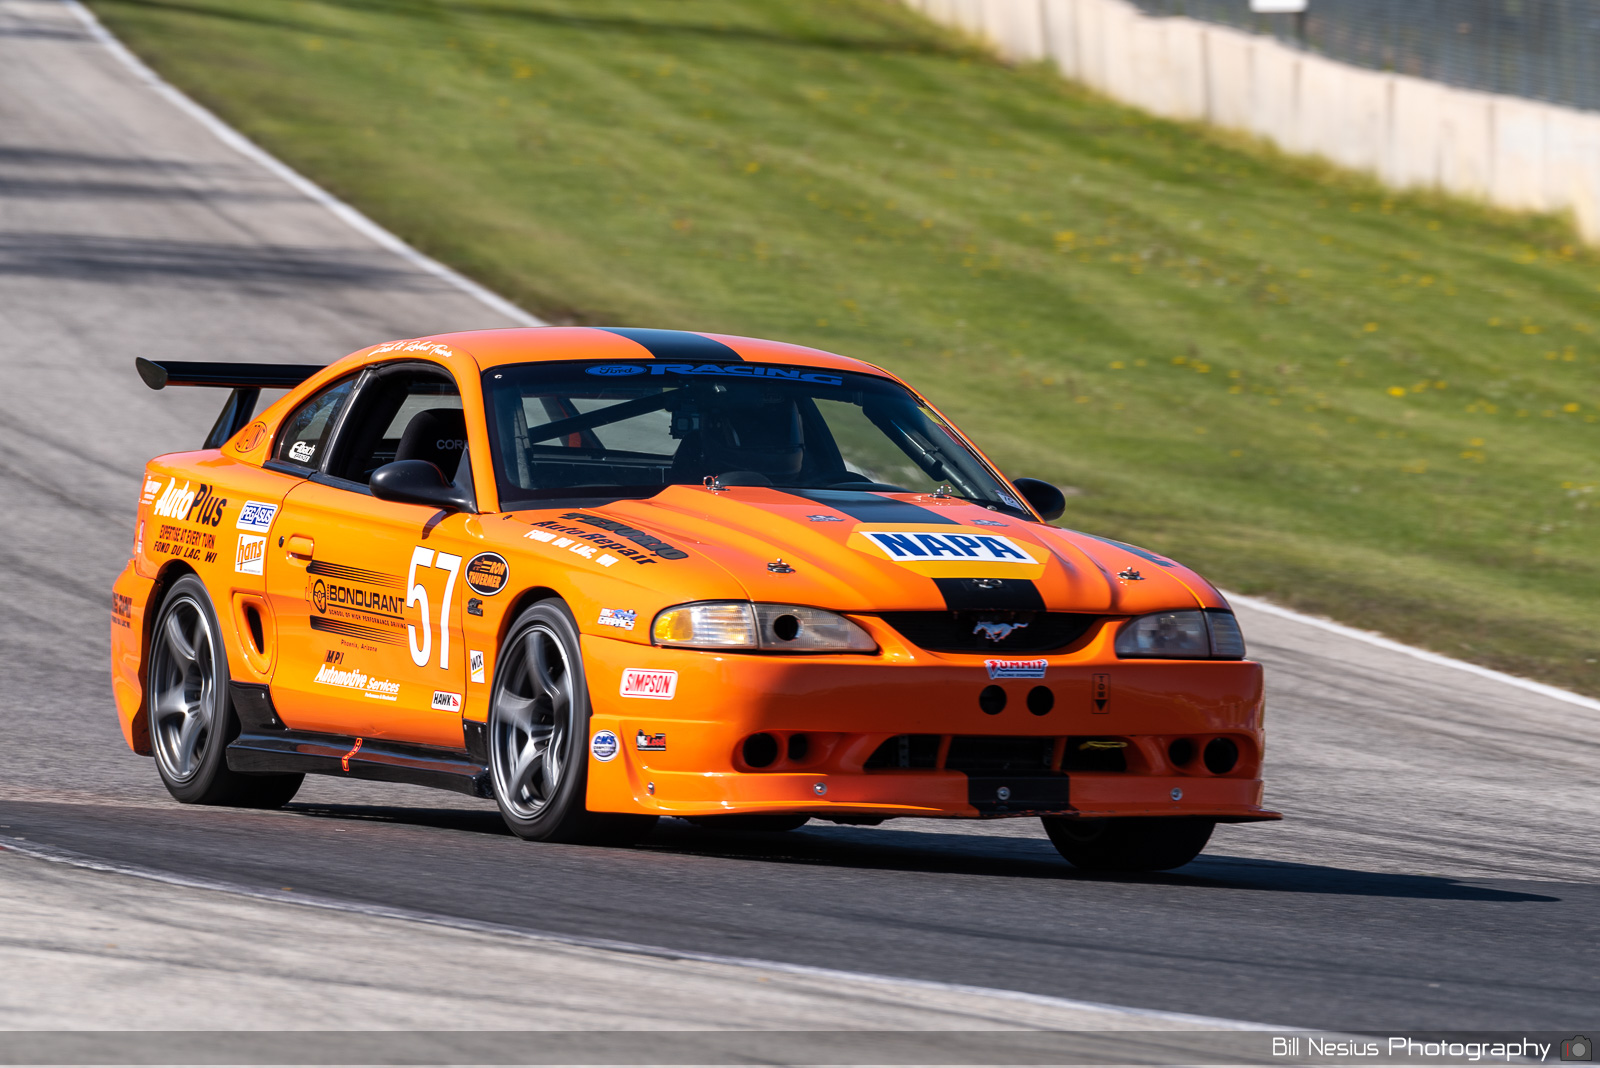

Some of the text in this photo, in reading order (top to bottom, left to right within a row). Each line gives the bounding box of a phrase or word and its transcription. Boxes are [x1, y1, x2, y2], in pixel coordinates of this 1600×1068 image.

[646, 364, 843, 386] RACING
[241, 505, 273, 524] PEGASUS
[159, 525, 182, 542] EXPERTISE
[186, 530, 203, 546] EVERY
[201, 533, 217, 550] TURN
[530, 520, 658, 565] Auto Repair
[870, 533, 1028, 560] NAPA
[153, 541, 170, 553] FOND
[170, 545, 183, 556] DU
[205, 551, 218, 563] WI
[237, 536, 264, 571] hans
[329, 584, 405, 614] BONDURANT
[406, 545, 463, 670] 57
[362, 616, 390, 626] PERFORMANCE
[390, 621, 407, 630] DRIVING
[471, 653, 483, 671] WIX
[988, 660, 1043, 672] SUMMIT
[314, 663, 400, 693] Automotive Services
[625, 673, 672, 694] SIMPSON
[433, 693, 452, 706] HAWK
